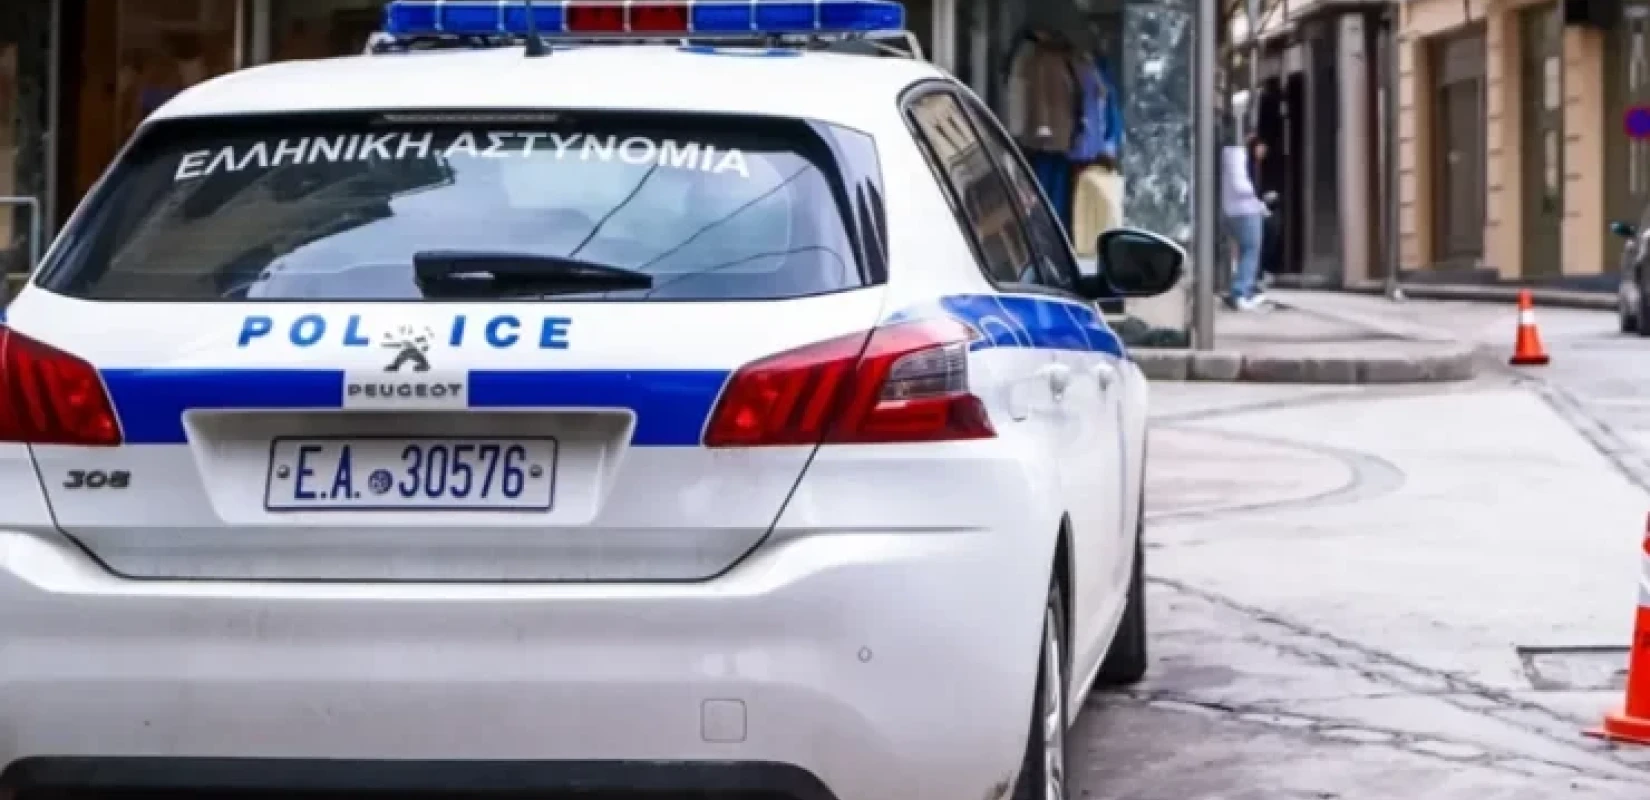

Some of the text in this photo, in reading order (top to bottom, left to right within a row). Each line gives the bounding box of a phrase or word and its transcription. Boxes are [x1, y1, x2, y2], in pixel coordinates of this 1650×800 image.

[174, 131, 750, 181] ΕΛΛΗΝΙΚΗ ΑΣΤΥΝΟΜΙΑ
[347, 383, 463, 398] PEUGEOT
[399, 444, 526, 499] 30576
